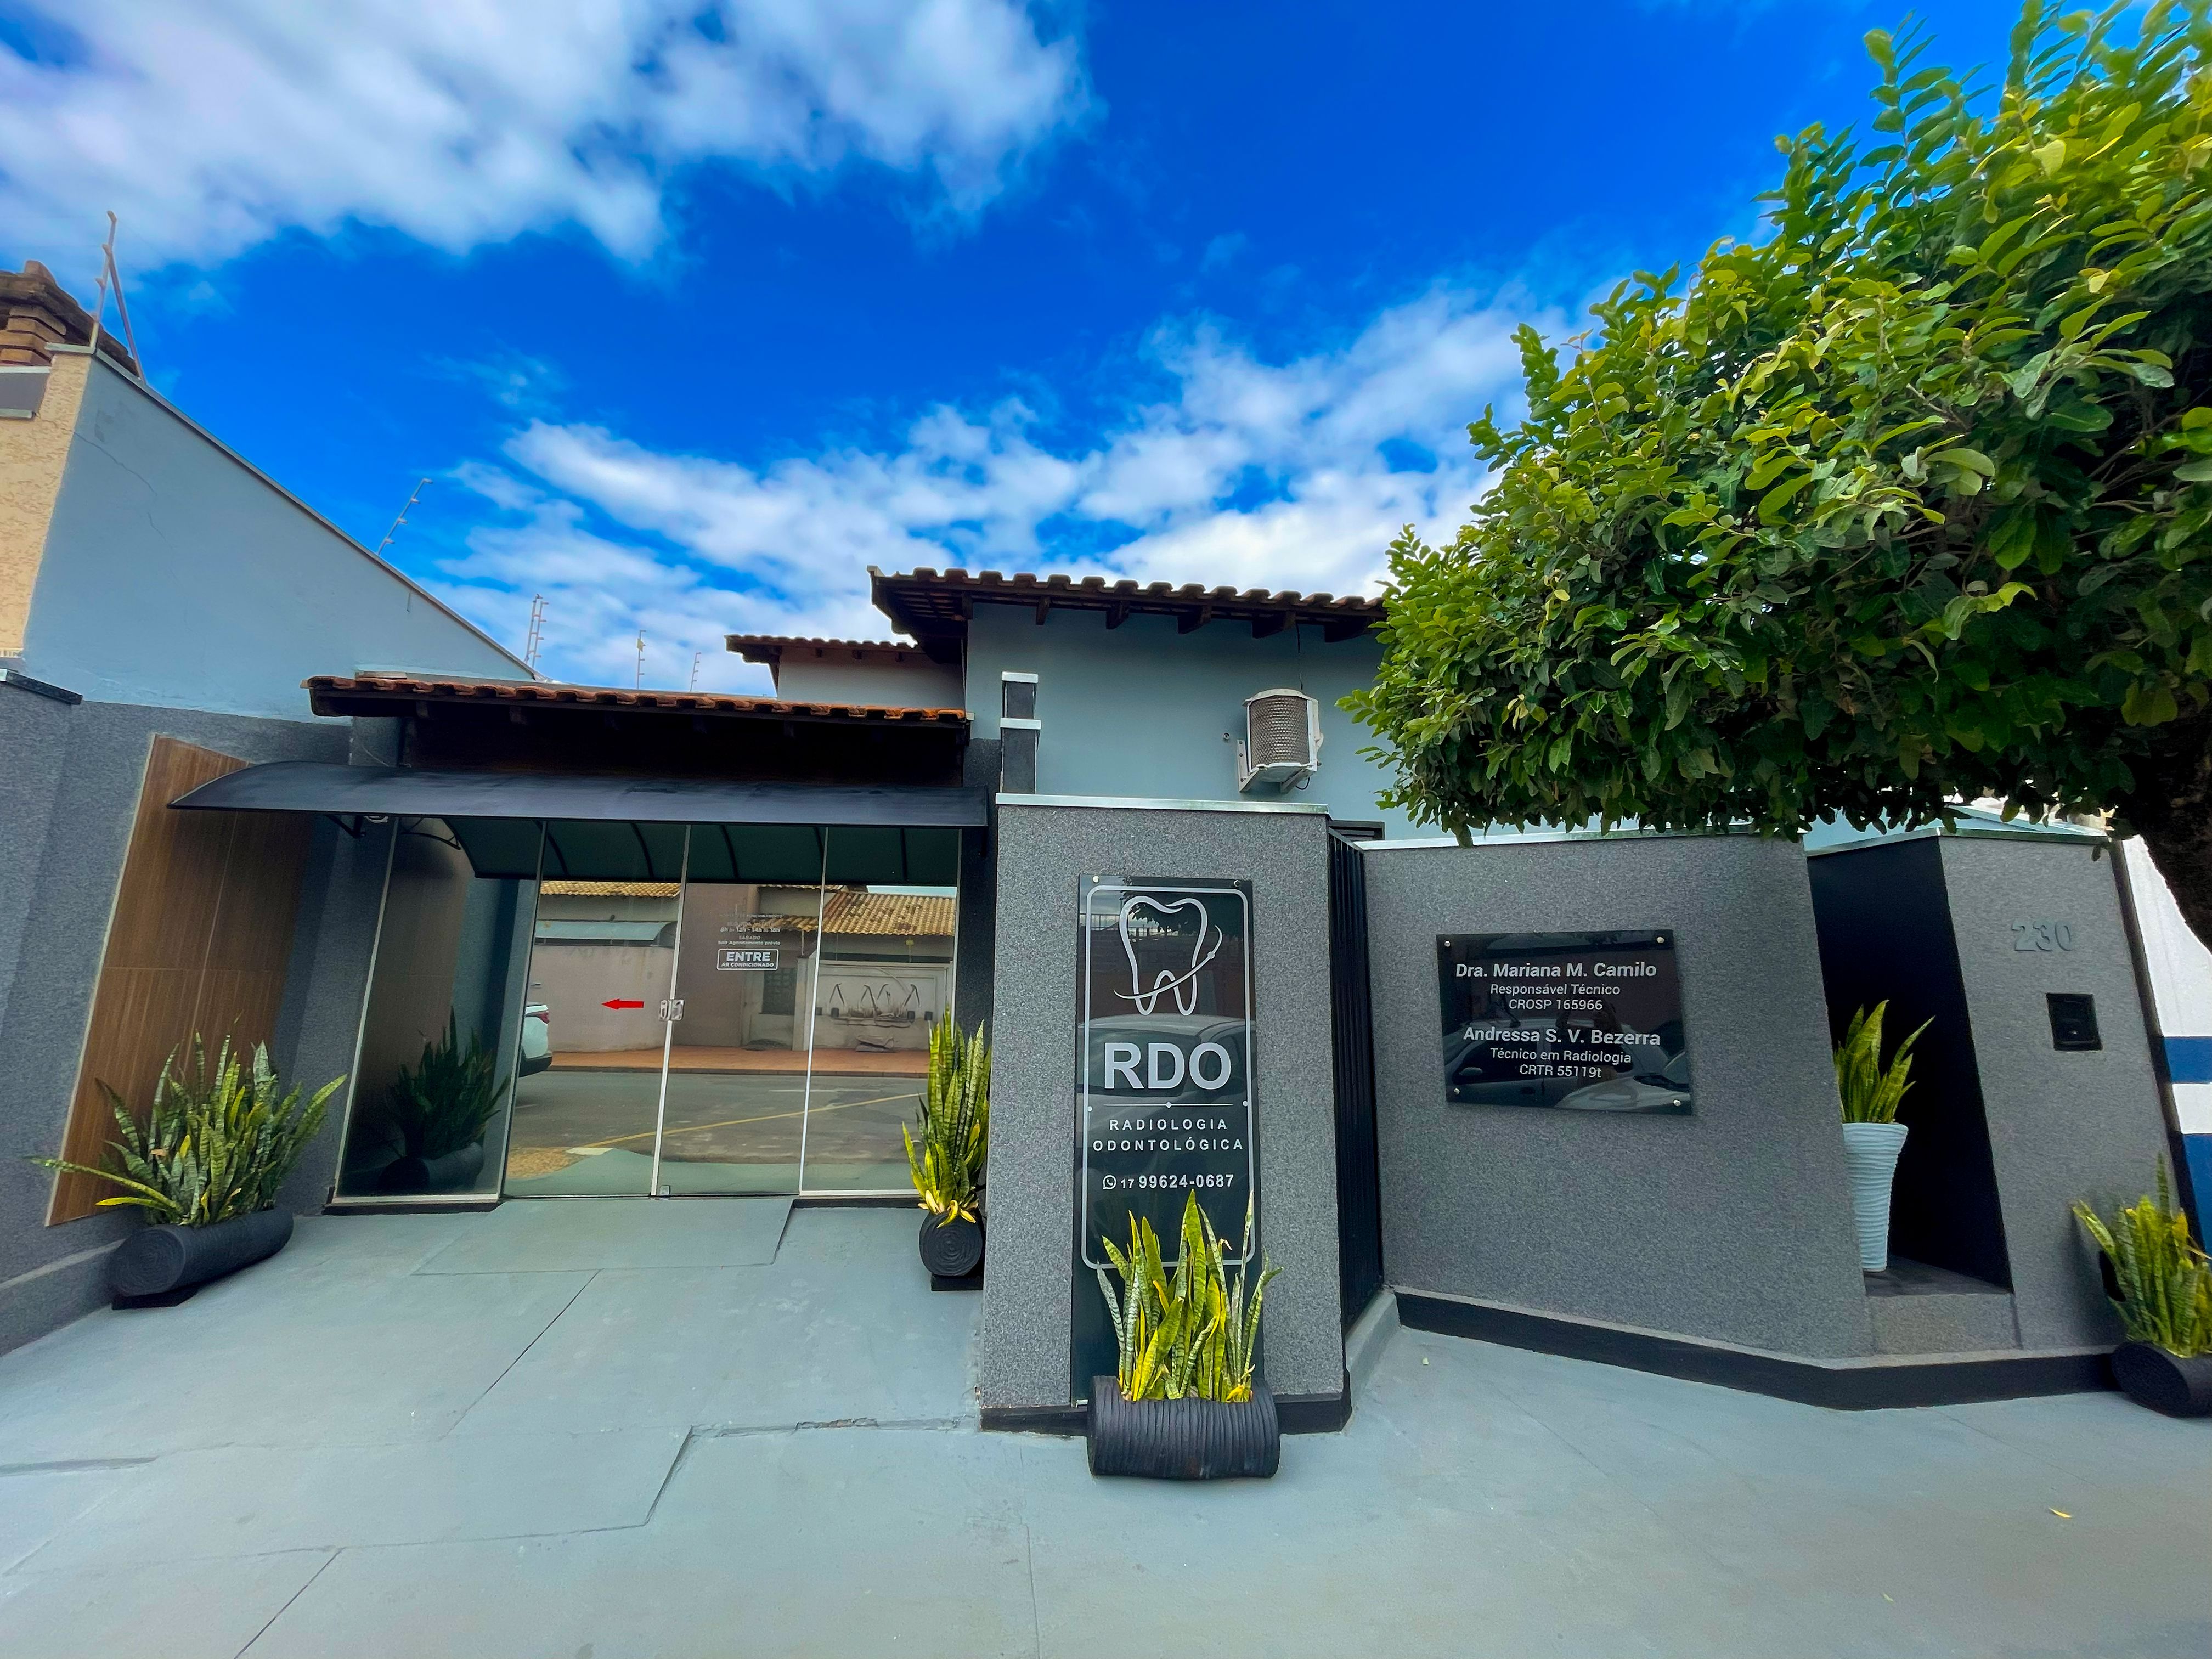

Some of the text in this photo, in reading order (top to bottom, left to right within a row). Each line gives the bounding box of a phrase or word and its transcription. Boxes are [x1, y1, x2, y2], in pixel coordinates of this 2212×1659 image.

[2010, 920, 2075, 952] 230
[726, 951, 771, 962] ENTRE
[1455, 961, 1657, 978] Dra. Mariana M. Camilo
[1490, 983, 1621, 997] Responsável Técnico
[1508, 998, 1603, 1011] CROSP 165966
[1463, 1026, 1661, 1046] Andressa S. V. Bezerra
[1489, 1047, 1632, 1066] Técnico em Radiologia
[1104, 1042, 1232, 1090] RDO
[1519, 1064, 1602, 1079] CRTR 55119t
[1109, 1118, 1228, 1131] RADIOLOGIA
[1092, 1136, 1243, 1152] ODONTOLÓGICA
[1120, 1173, 1234, 1189] 17 99624-0687
